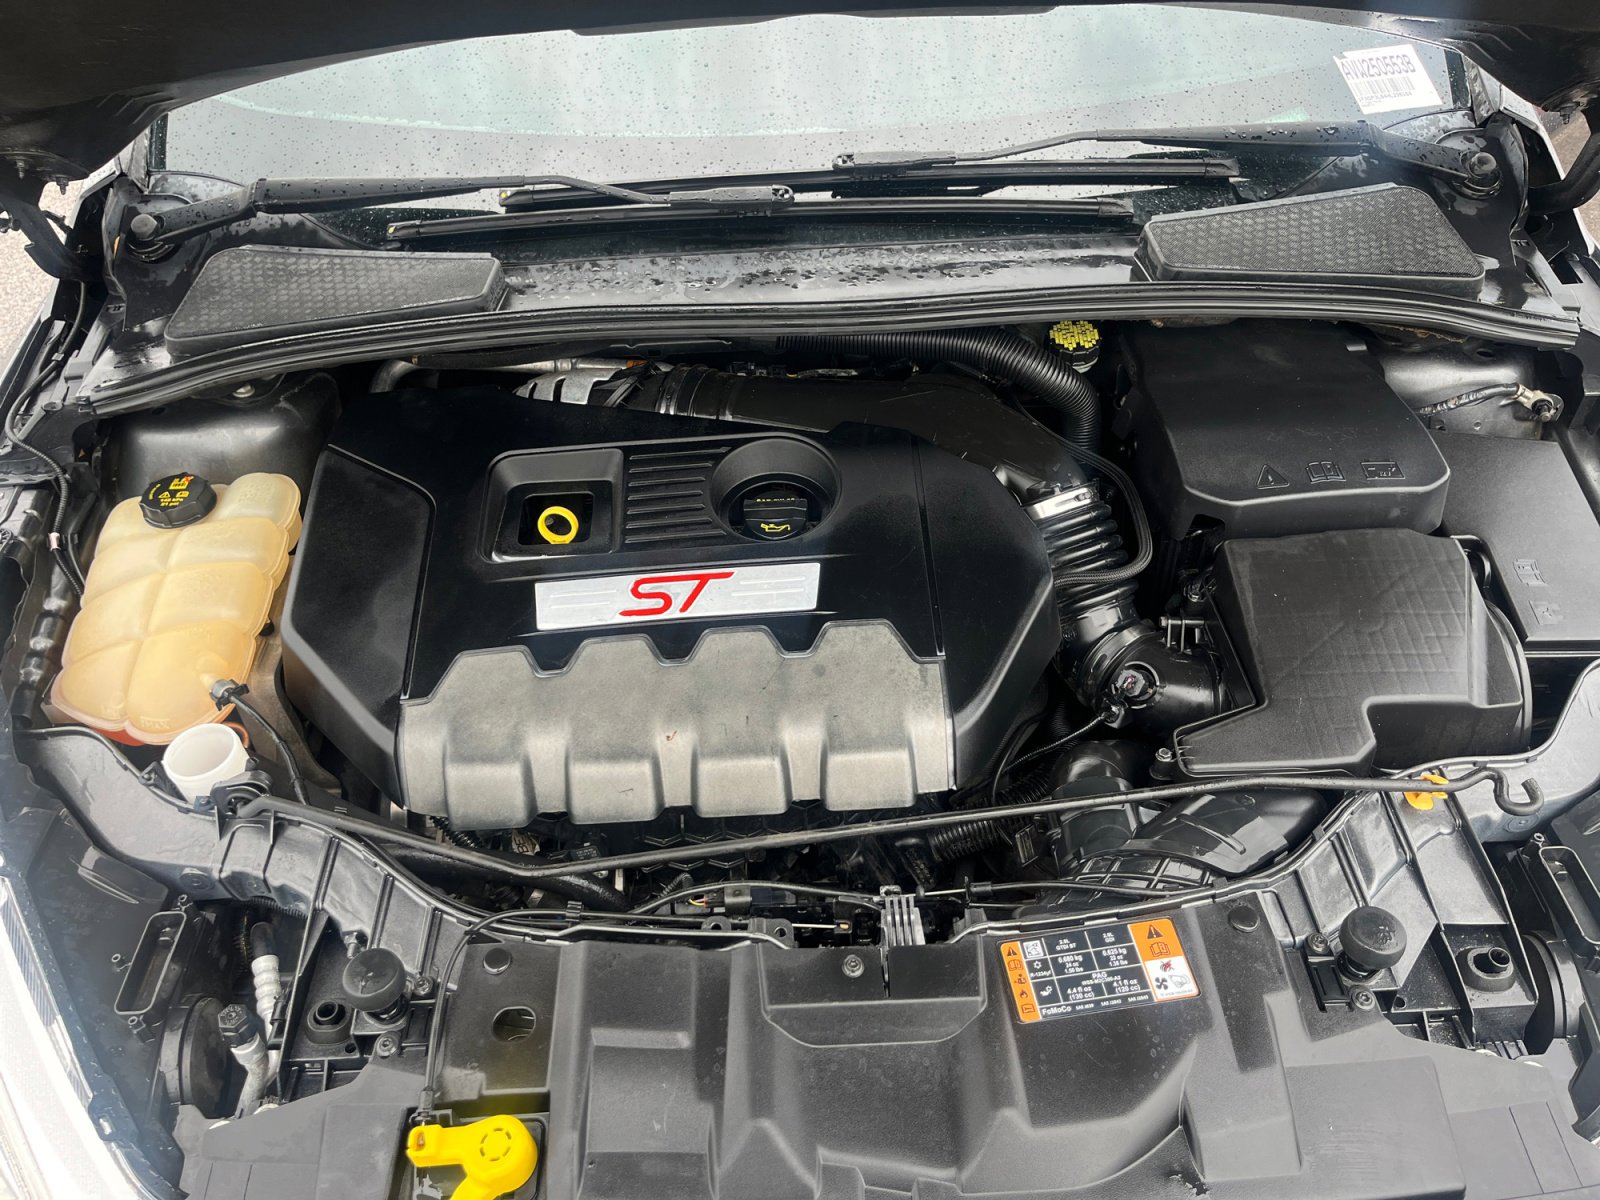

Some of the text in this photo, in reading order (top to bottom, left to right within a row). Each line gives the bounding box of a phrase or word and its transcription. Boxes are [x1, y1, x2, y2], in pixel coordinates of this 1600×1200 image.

[1340, 54, 1416, 81] AVW250553B
[619, 571, 735, 616] ST
[1118, 948, 1128, 956] kg
[1074, 954, 1083, 962] kg
[1130, 984, 1141, 992] cc)
[1084, 992, 1095, 1000] cc)
[1042, 1005, 1072, 1016] FoMoCo
